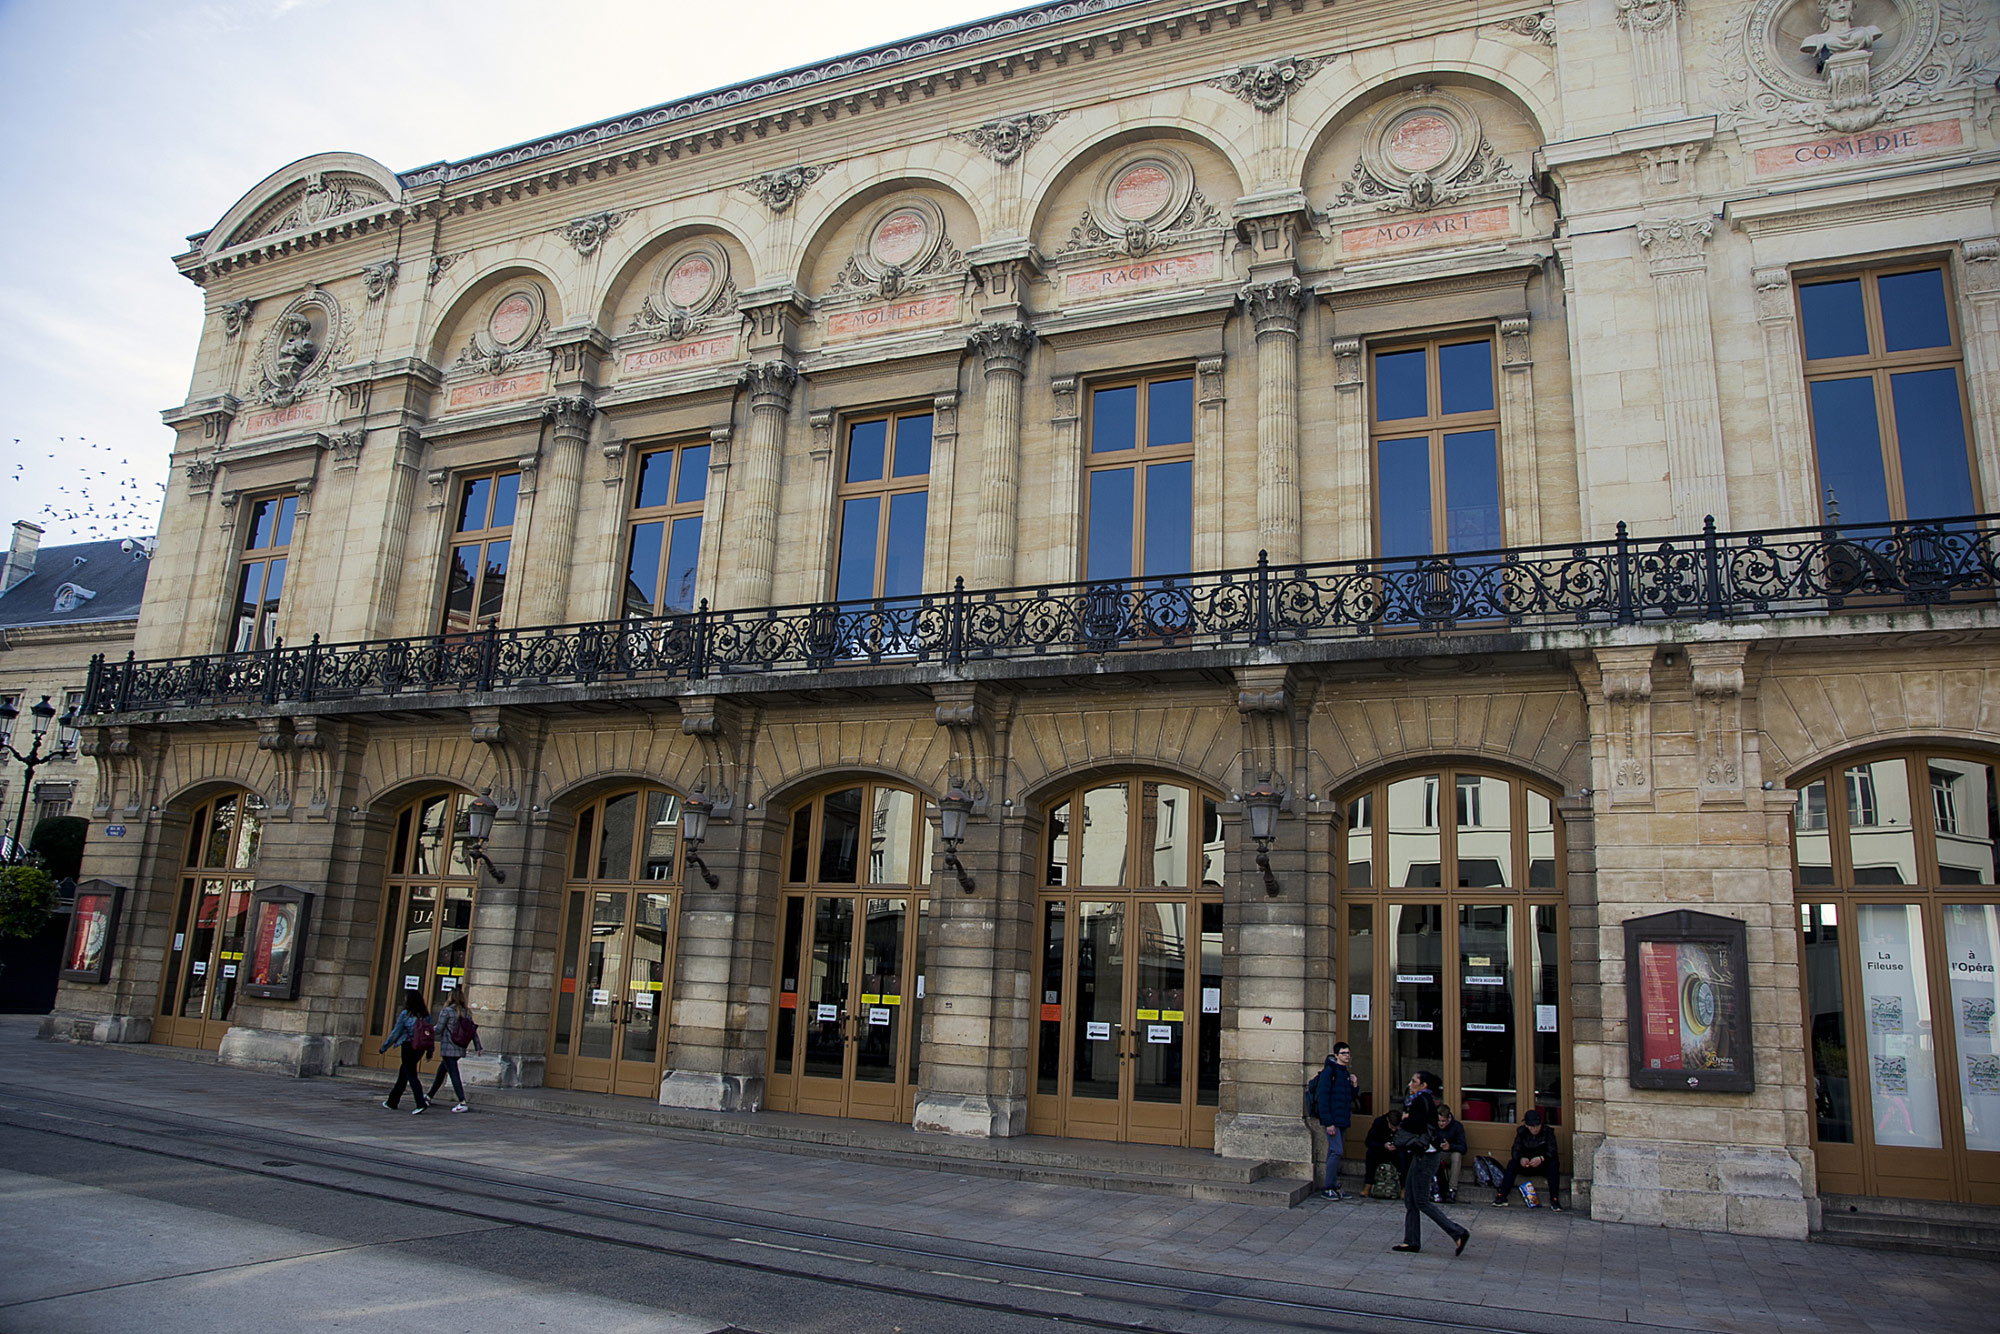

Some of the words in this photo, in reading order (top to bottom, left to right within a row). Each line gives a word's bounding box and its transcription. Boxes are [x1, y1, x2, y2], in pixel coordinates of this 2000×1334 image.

[1795, 131, 1918, 162] COMEDIE
[1376, 216, 1472, 243] MOZART
[1102, 262, 1176, 285] RACINE
[852, 304, 930, 325] MOLIERE
[639, 343, 719, 365] CORNEILLE
[477, 381, 517, 396] AUBER
[260, 409, 311, 425] TRAGEDIE
[1878, 951, 1891, 960] La
[1968, 950, 1976, 960] à
[1867, 961, 1904, 971] Fileuse
[1952, 961, 1995, 973] l'Opéra
